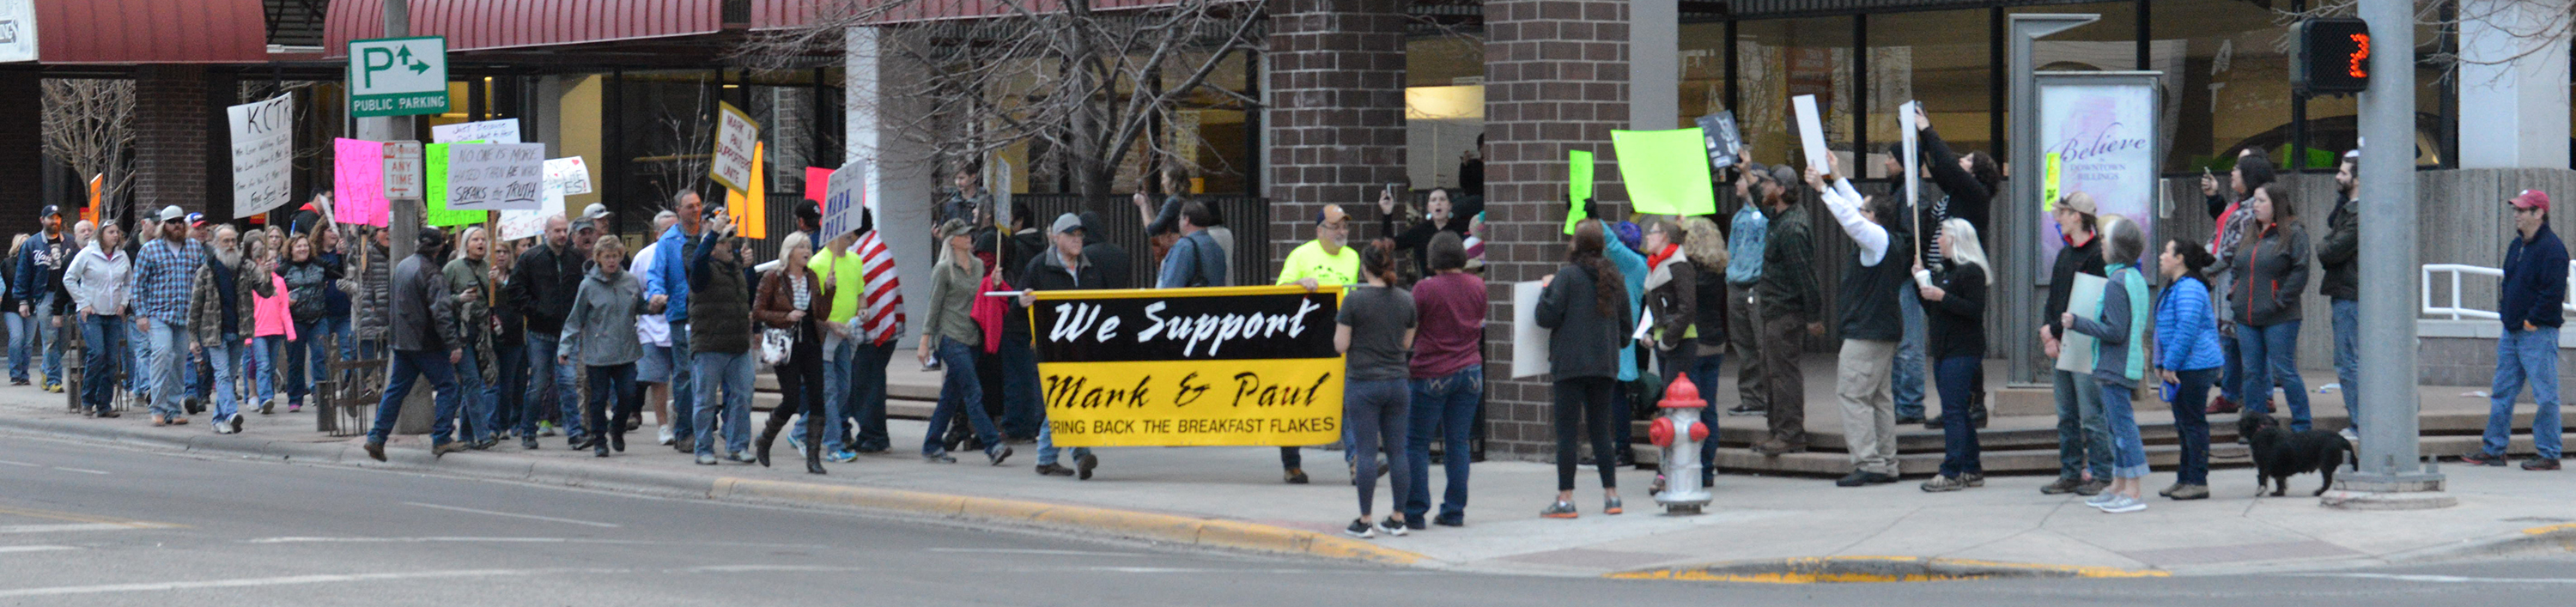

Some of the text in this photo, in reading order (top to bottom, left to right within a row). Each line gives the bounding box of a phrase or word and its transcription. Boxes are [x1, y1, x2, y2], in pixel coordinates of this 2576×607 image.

[2350, 33, 2369, 77] 2
[364, 47, 394, 88] P
[354, 96, 446, 112] PUBLIC PARKING
[2047, 122, 2147, 163] Believe
[458, 149, 475, 163] NO
[495, 147, 507, 161] IS
[509, 147, 539, 163] MORE
[392, 161, 411, 173] ANY
[2070, 163, 2126, 173] DOWNTOWN
[391, 174, 414, 185] TIME
[453, 185, 488, 203] SPEAKS
[505, 180, 538, 198] TRUTH
[1048, 298, 1321, 357] We Support
[1045, 369, 1331, 410] Mark & Paul
[1093, 418, 1135, 434] BACK
[1143, 418, 1170, 434] THE
[1177, 417, 1265, 434] BREAKFAST
[1271, 416, 1335, 433] FLAKES
